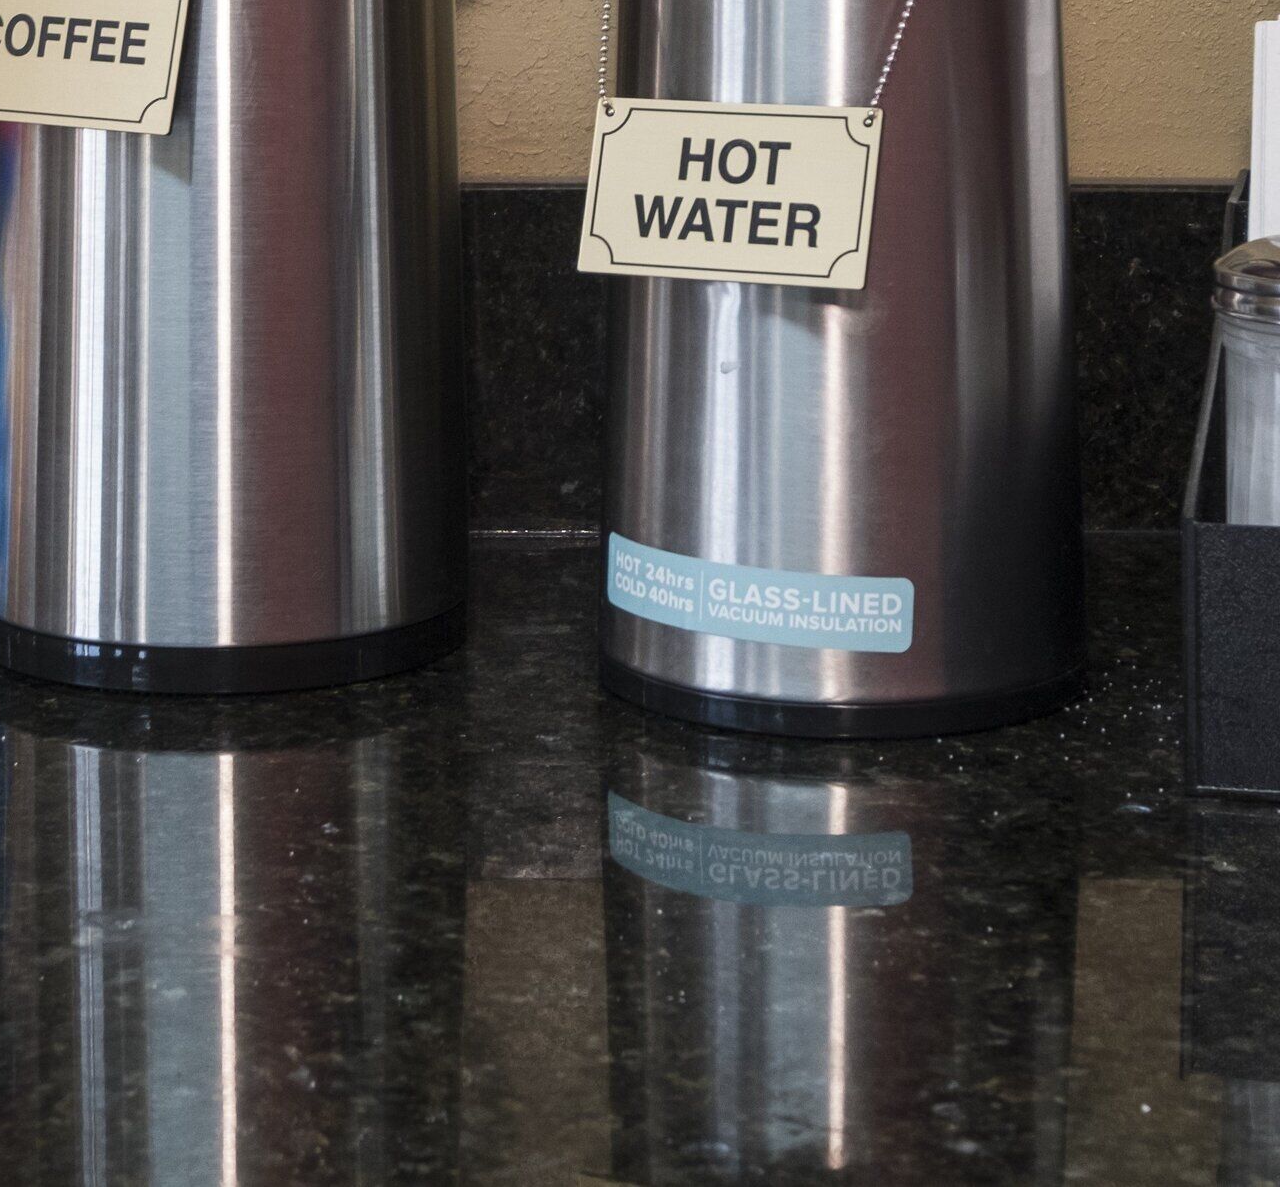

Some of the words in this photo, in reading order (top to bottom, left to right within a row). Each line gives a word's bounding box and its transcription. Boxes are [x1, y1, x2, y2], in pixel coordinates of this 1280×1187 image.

[677, 137, 792, 185] HOT
[634, 194, 821, 248] WATER
[615, 550, 641, 575] HOT
[645, 563, 694, 591] 24hrs
[615, 572, 646, 598] COLD
[649, 586, 694, 613] 40hrs
[708, 578, 903, 615] GLASS-LINED
[707, 602, 784, 627] VACUUM
[789, 615, 903, 633] INSULATION
